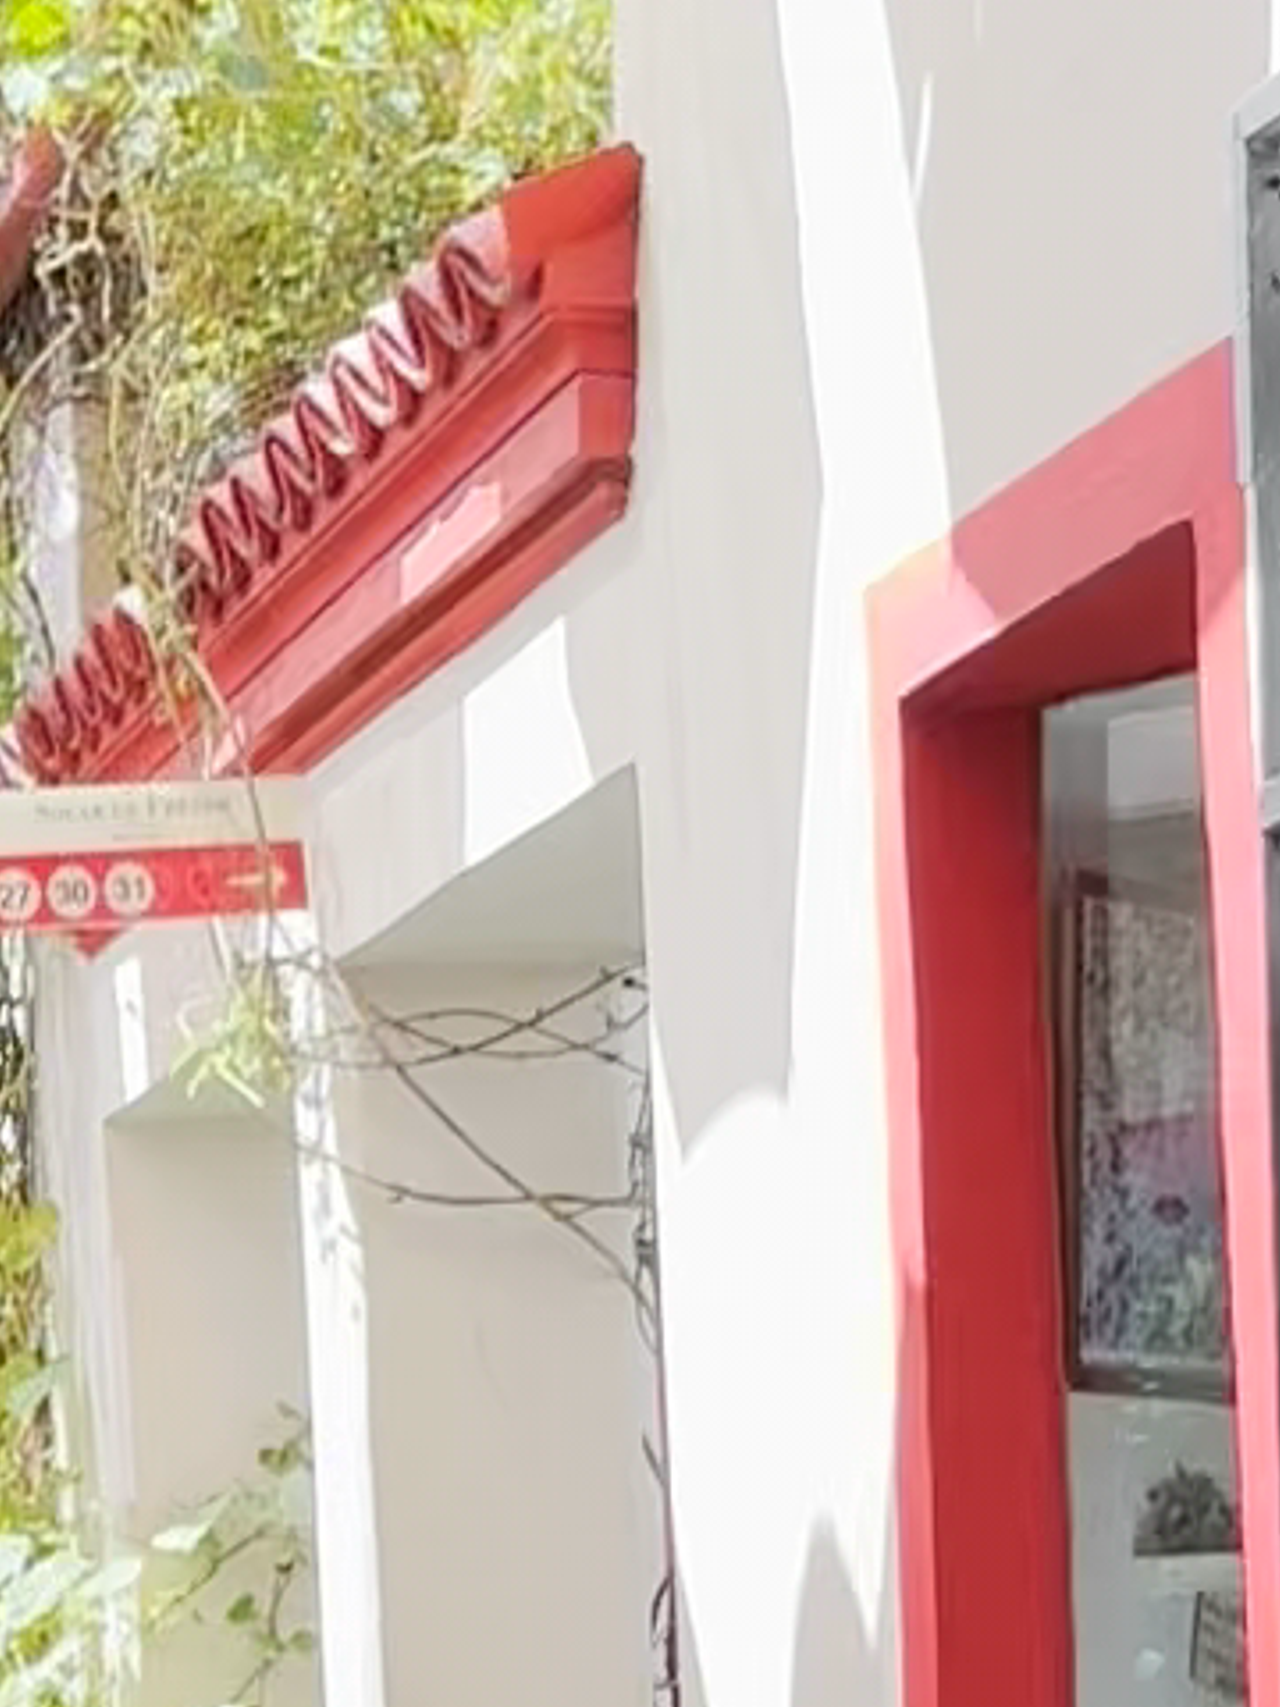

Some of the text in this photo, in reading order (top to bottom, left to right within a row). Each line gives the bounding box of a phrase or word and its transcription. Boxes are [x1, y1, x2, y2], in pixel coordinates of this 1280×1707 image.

[0, 875, 146, 911] 27 30 31
